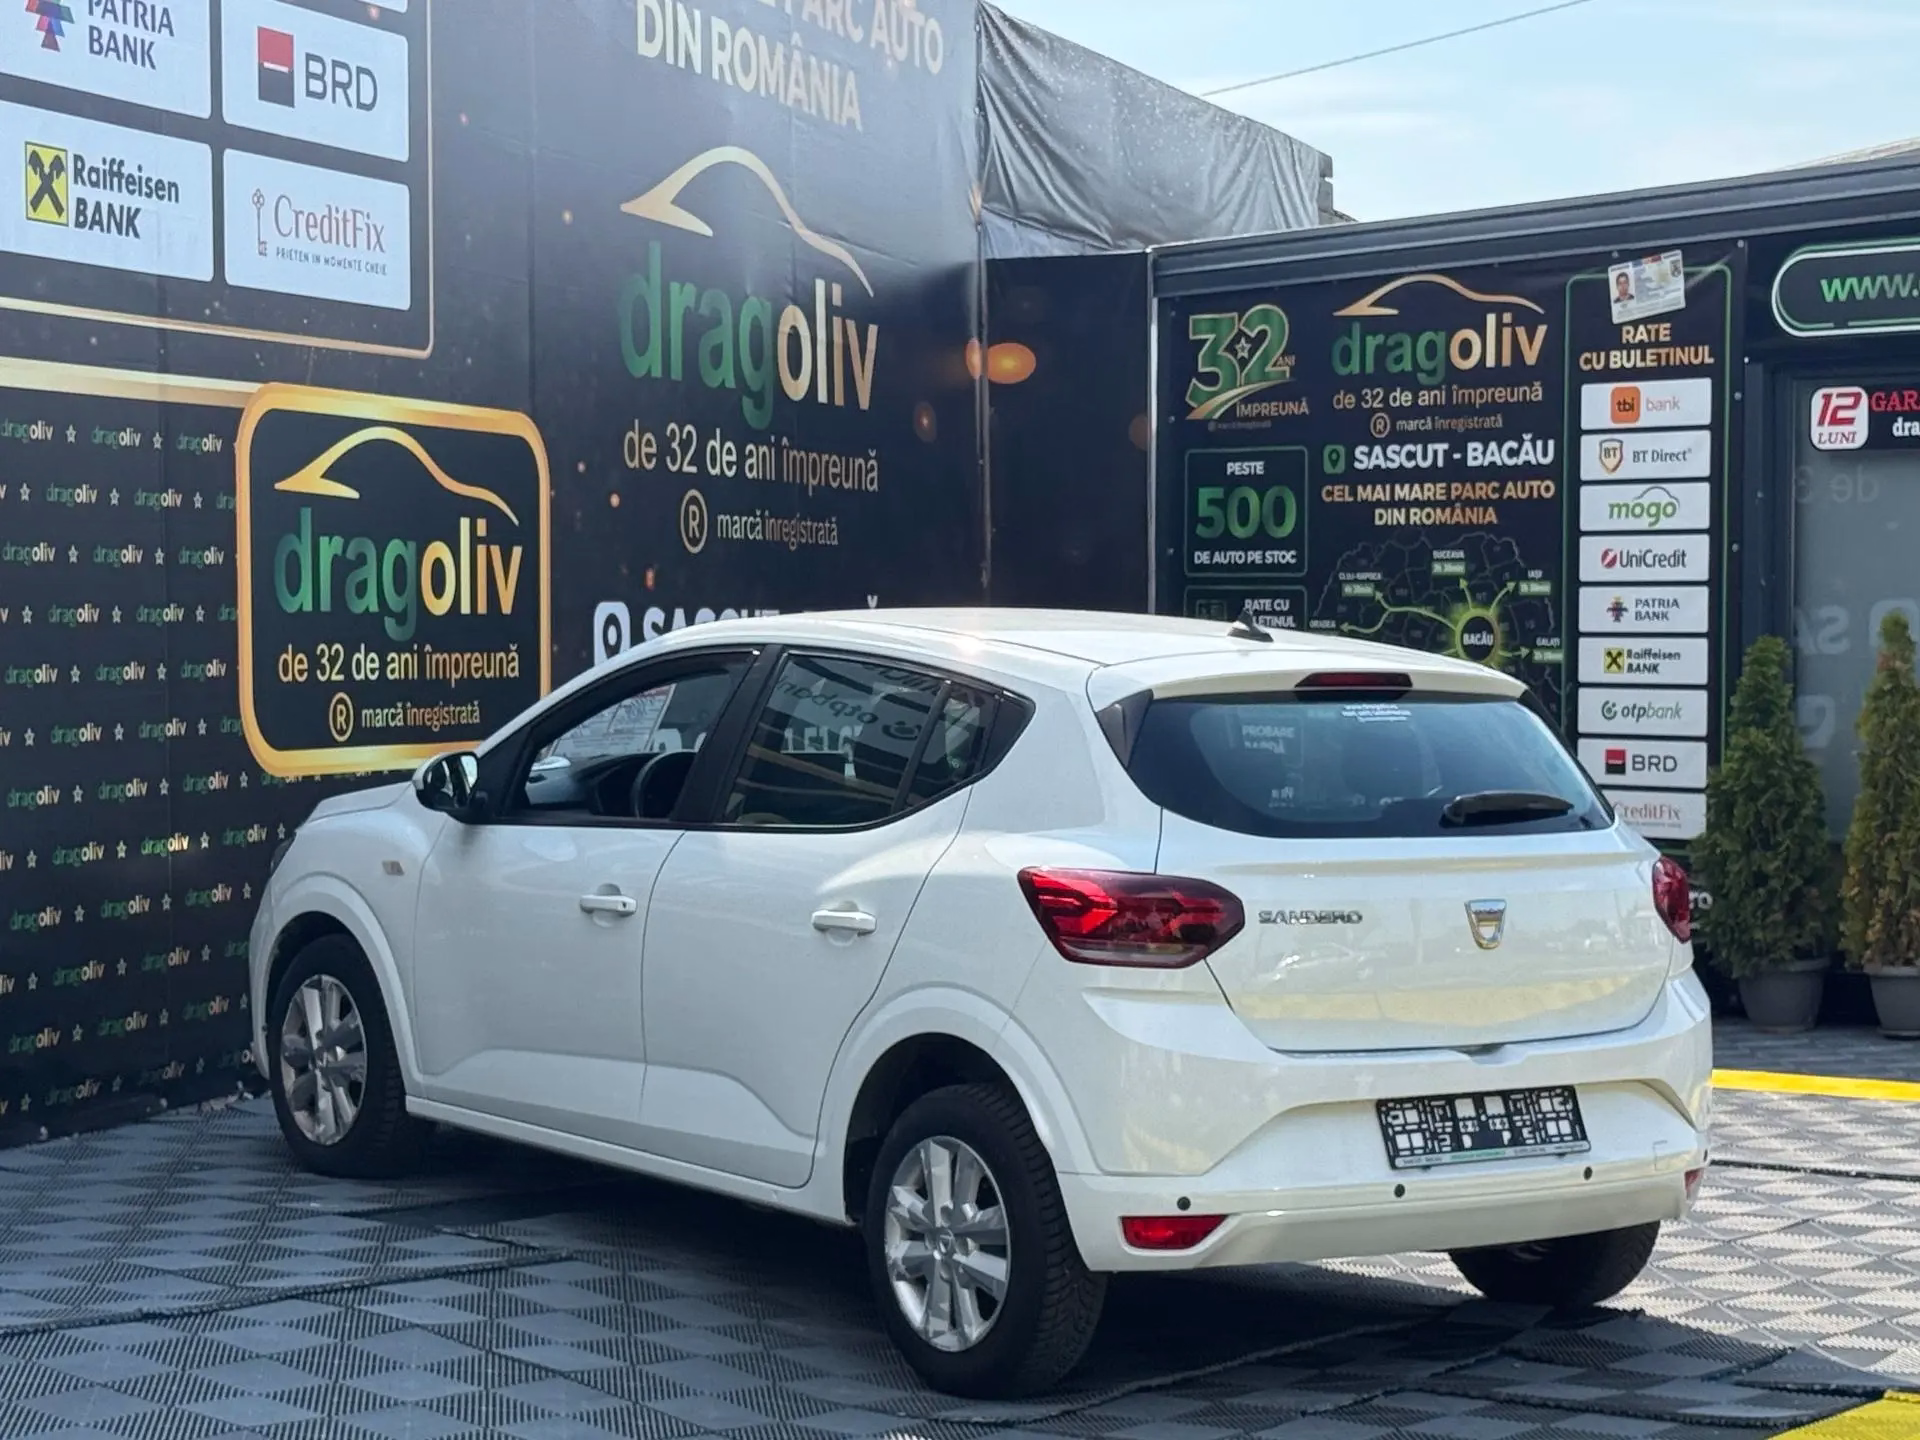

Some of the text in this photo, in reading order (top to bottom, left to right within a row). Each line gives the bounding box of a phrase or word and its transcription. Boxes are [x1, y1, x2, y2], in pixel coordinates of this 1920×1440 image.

[88, 24, 157, 70] BANK
[869, 0, 944, 75] AUTO
[636, 0, 863, 133] DIN ROMÂNIA
[304, 52, 379, 112] BRD
[73, 154, 180, 203] Raiffeisen
[74, 197, 142, 239] BANK
[273, 194, 387, 254] CreditFix
[619, 240, 878, 429] dragoliv
[1621, 323, 1671, 344] RATE
[1185, 303, 1291, 408] 32
[1332, 312, 1548, 386] dragoliv
[1579, 345, 1715, 371] CU BULETINUL
[1333, 381, 1543, 410] de 32 de ani împreună
[1616, 393, 1680, 412] tbi bank
[1816, 391, 1863, 427] 12
[1, 420, 222, 454] dragoliv dragoliv dragoliv
[1396, 416, 1432, 432] marcă
[1434, 413, 1503, 433] înregistrată
[1817, 431, 1857, 444] LUNI
[623, 418, 879, 497] de 32 de ani împreună
[1353, 443, 1449, 470] SASCUT
[1466, 433, 1554, 467] BACĂU
[1632, 450, 1648, 464] BT
[1226, 461, 1265, 475] PESTE
[46, 483, 182, 508] dragoliv dragoliv
[1321, 479, 1555, 503] CEL MAI MARE PARC AUTO
[1195, 485, 1297, 539] 500
[1374, 502, 1498, 526] DIN ROMÂNIA
[1608, 499, 1677, 527] mogo
[717, 509, 763, 542] marcă
[764, 513, 838, 551] înregistrată
[2, 542, 224, 568] dragoliv dragoliv dragoliv
[1194, 551, 1297, 564] DE AUTO PE STOC
[1619, 549, 1687, 569] UniCredit
[273, 507, 523, 641] dragoliv
[48, 603, 184, 628] dragoliv dragoliv
[1273, 599, 1290, 611] CU
[1634, 598, 1680, 610] PATRIA
[1634, 609, 1669, 621] BANK
[1462, 631, 1494, 646] BACĂU
[278, 643, 519, 688] de 32 de ani împreună
[1626, 648, 1681, 662] Raiffeisen
[1626, 663, 1660, 674] BANK
[5, 659, 227, 688] dragoliv dragoliv dragoliv
[361, 701, 404, 728] marcă
[406, 700, 480, 733] înregistrată
[1620, 702, 1682, 722] otpbank
[51, 717, 187, 747] dragoliv dragoliv
[1631, 754, 1678, 773] BRD
[7, 771, 229, 809] dragoliv dragoliv dragoliv
[52, 824, 267, 867] dragoliv dragoliv dragoliv
[10, 883, 232, 932] dragoliv dragoliv dragoliv
[1258, 910, 1363, 925] SANDERO
[53, 946, 190, 987] dragoliv dragoliv
